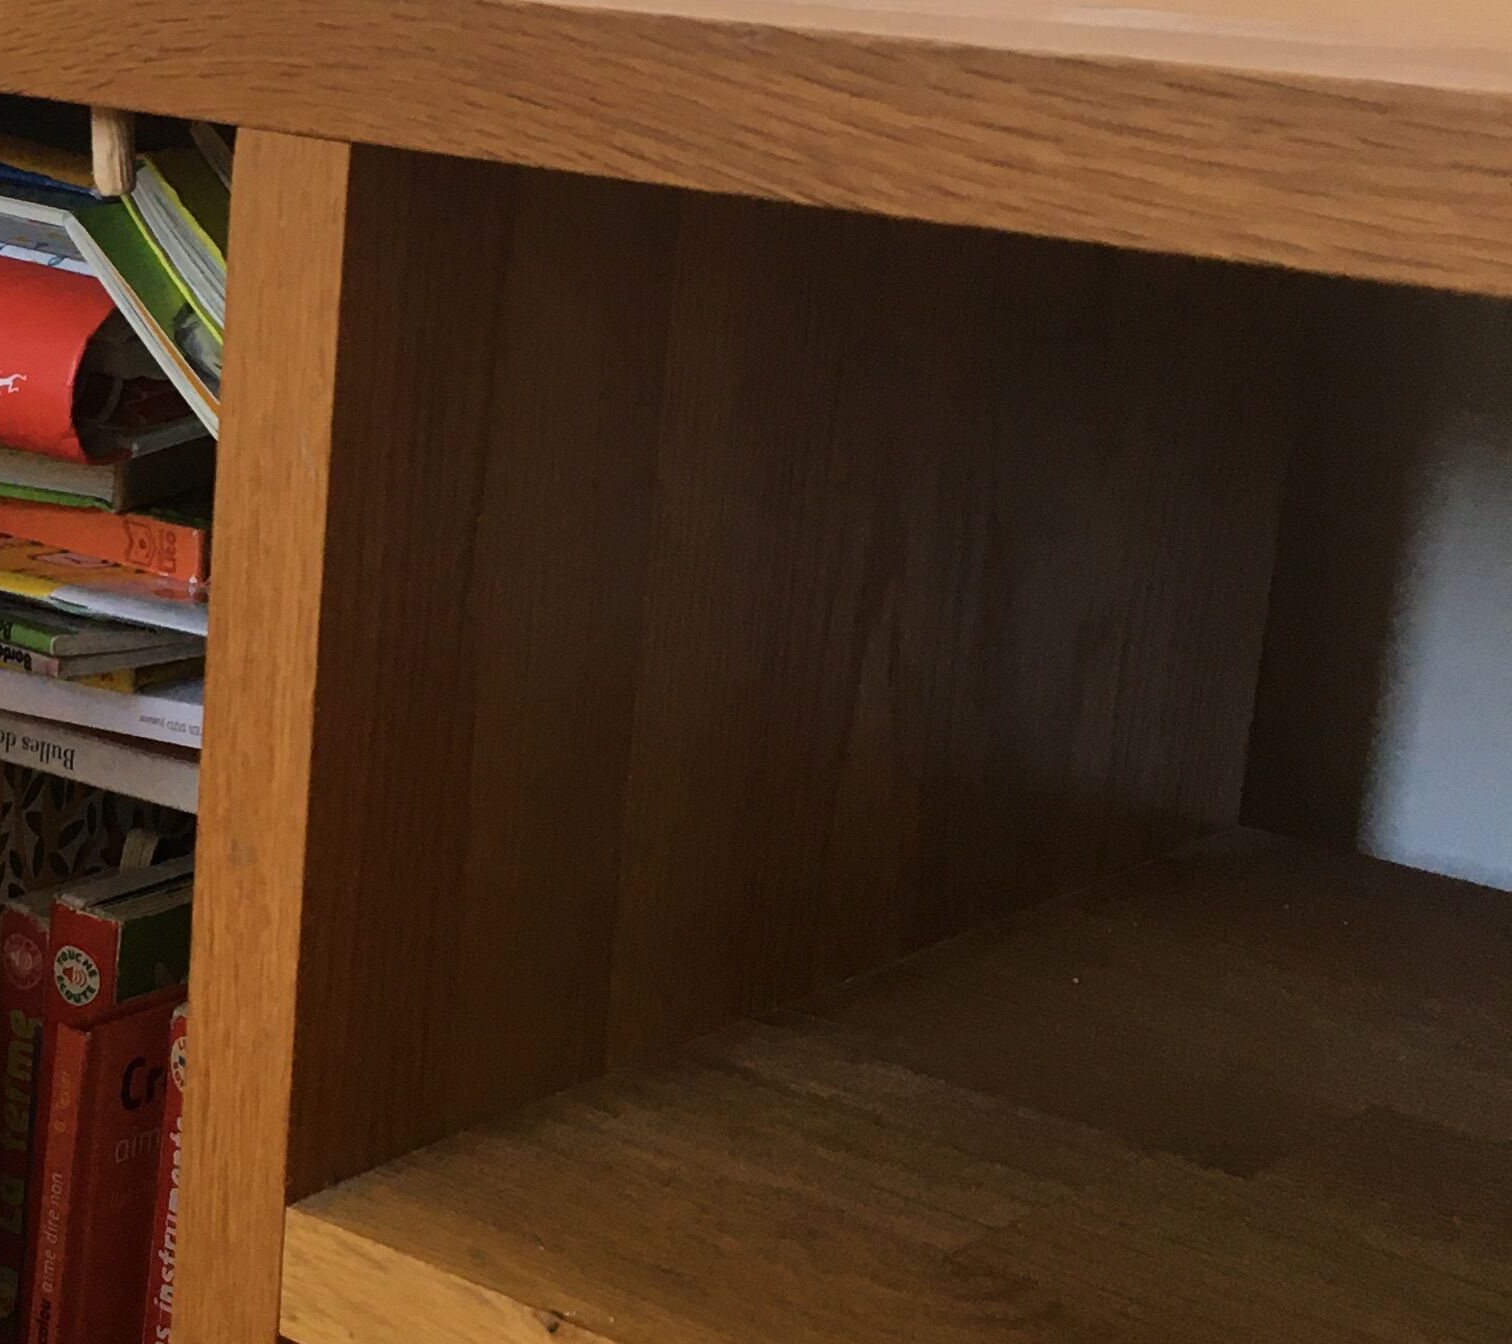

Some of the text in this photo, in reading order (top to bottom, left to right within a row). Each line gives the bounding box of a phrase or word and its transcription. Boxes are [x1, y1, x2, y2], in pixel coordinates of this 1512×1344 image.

[22, 733, 75, 771] Bulles
[56, 948, 98, 978] TOUCHE
[50, 1170, 65, 1207] non
[43, 1211, 61, 1245] dire
[39, 1246, 57, 1294] aime
